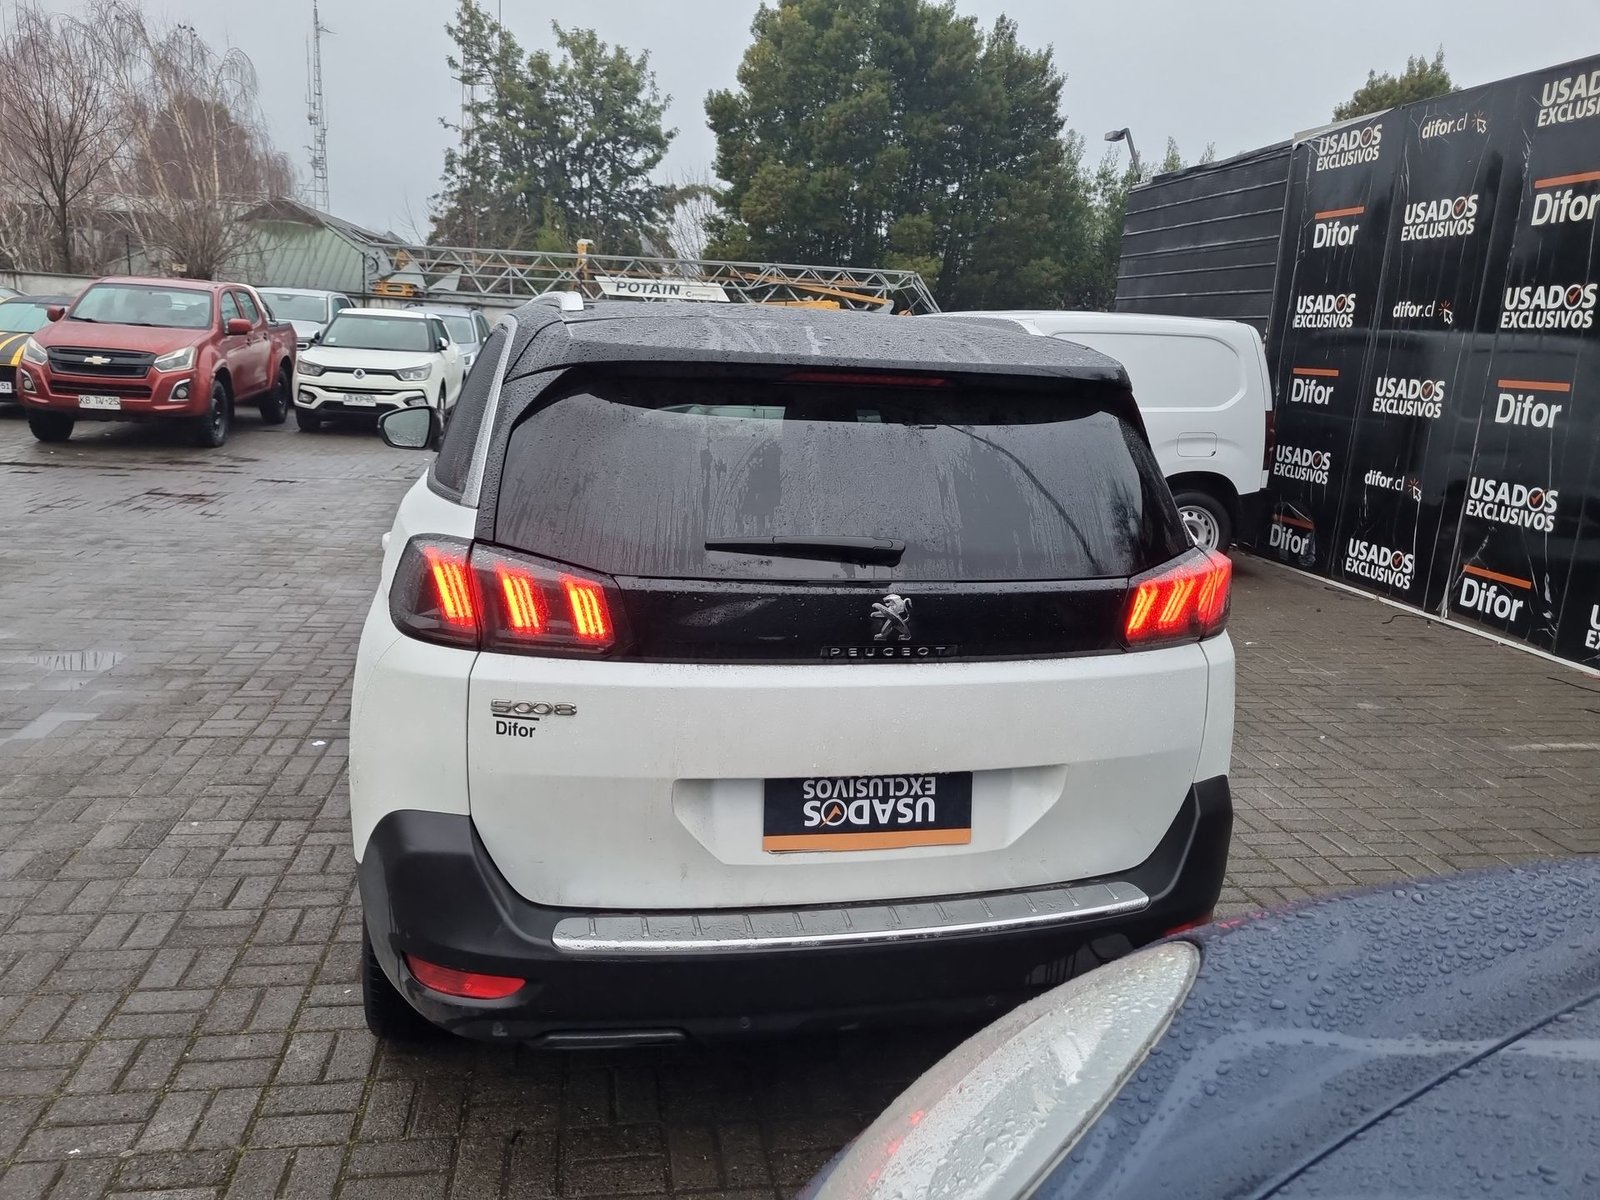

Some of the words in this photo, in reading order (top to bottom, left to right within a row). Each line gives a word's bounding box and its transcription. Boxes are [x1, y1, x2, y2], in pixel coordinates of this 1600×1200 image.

[1421, 113, 1467, 139] difor.cl
[1318, 124, 1382, 155] USADOS
[1316, 146, 1379, 171] EXCLUSIVOS
[1404, 194, 1479, 225] USADOS
[1531, 189, 1600, 225] Difor
[1313, 221, 1359, 248] Difor
[1401, 217, 1475, 241] EXCLUSIVOS
[616, 282, 680, 295] POTAIN
[1504, 283, 1598, 310] USADOS
[1296, 293, 1355, 314] USADOS
[1393, 300, 1435, 318] difor.cl
[1293, 313, 1353, 328] EXCLUSIVOS
[1500, 308, 1594, 329] EXCLUSIVOS
[1291, 378, 1333, 405] Difor
[1375, 376, 1445, 401] USADOS
[1372, 399, 1442, 419] EXCLUSIVOS
[1495, 393, 1562, 428] Difor
[1276, 444, 1331, 470] USADOS
[1273, 462, 1329, 485] EXCLUSIVOS
[1364, 469, 1404, 491] difor.cl
[1469, 476, 1558, 513] USADOS
[1466, 499, 1555, 532] EXCLUSIVOS
[1269, 523, 1309, 555] Difor
[1348, 537, 1414, 573] USADOS
[1345, 556, 1411, 590] EXCLUSIVOS
[1459, 577, 1523, 621] Difor
[830, 647, 946, 657] PEUGEOT
[491, 699, 577, 716] 5008
[496, 720, 536, 738] Difor
[803, 776, 936, 799] EXCLUSIVOS
[803, 797, 935, 827] USADOS
